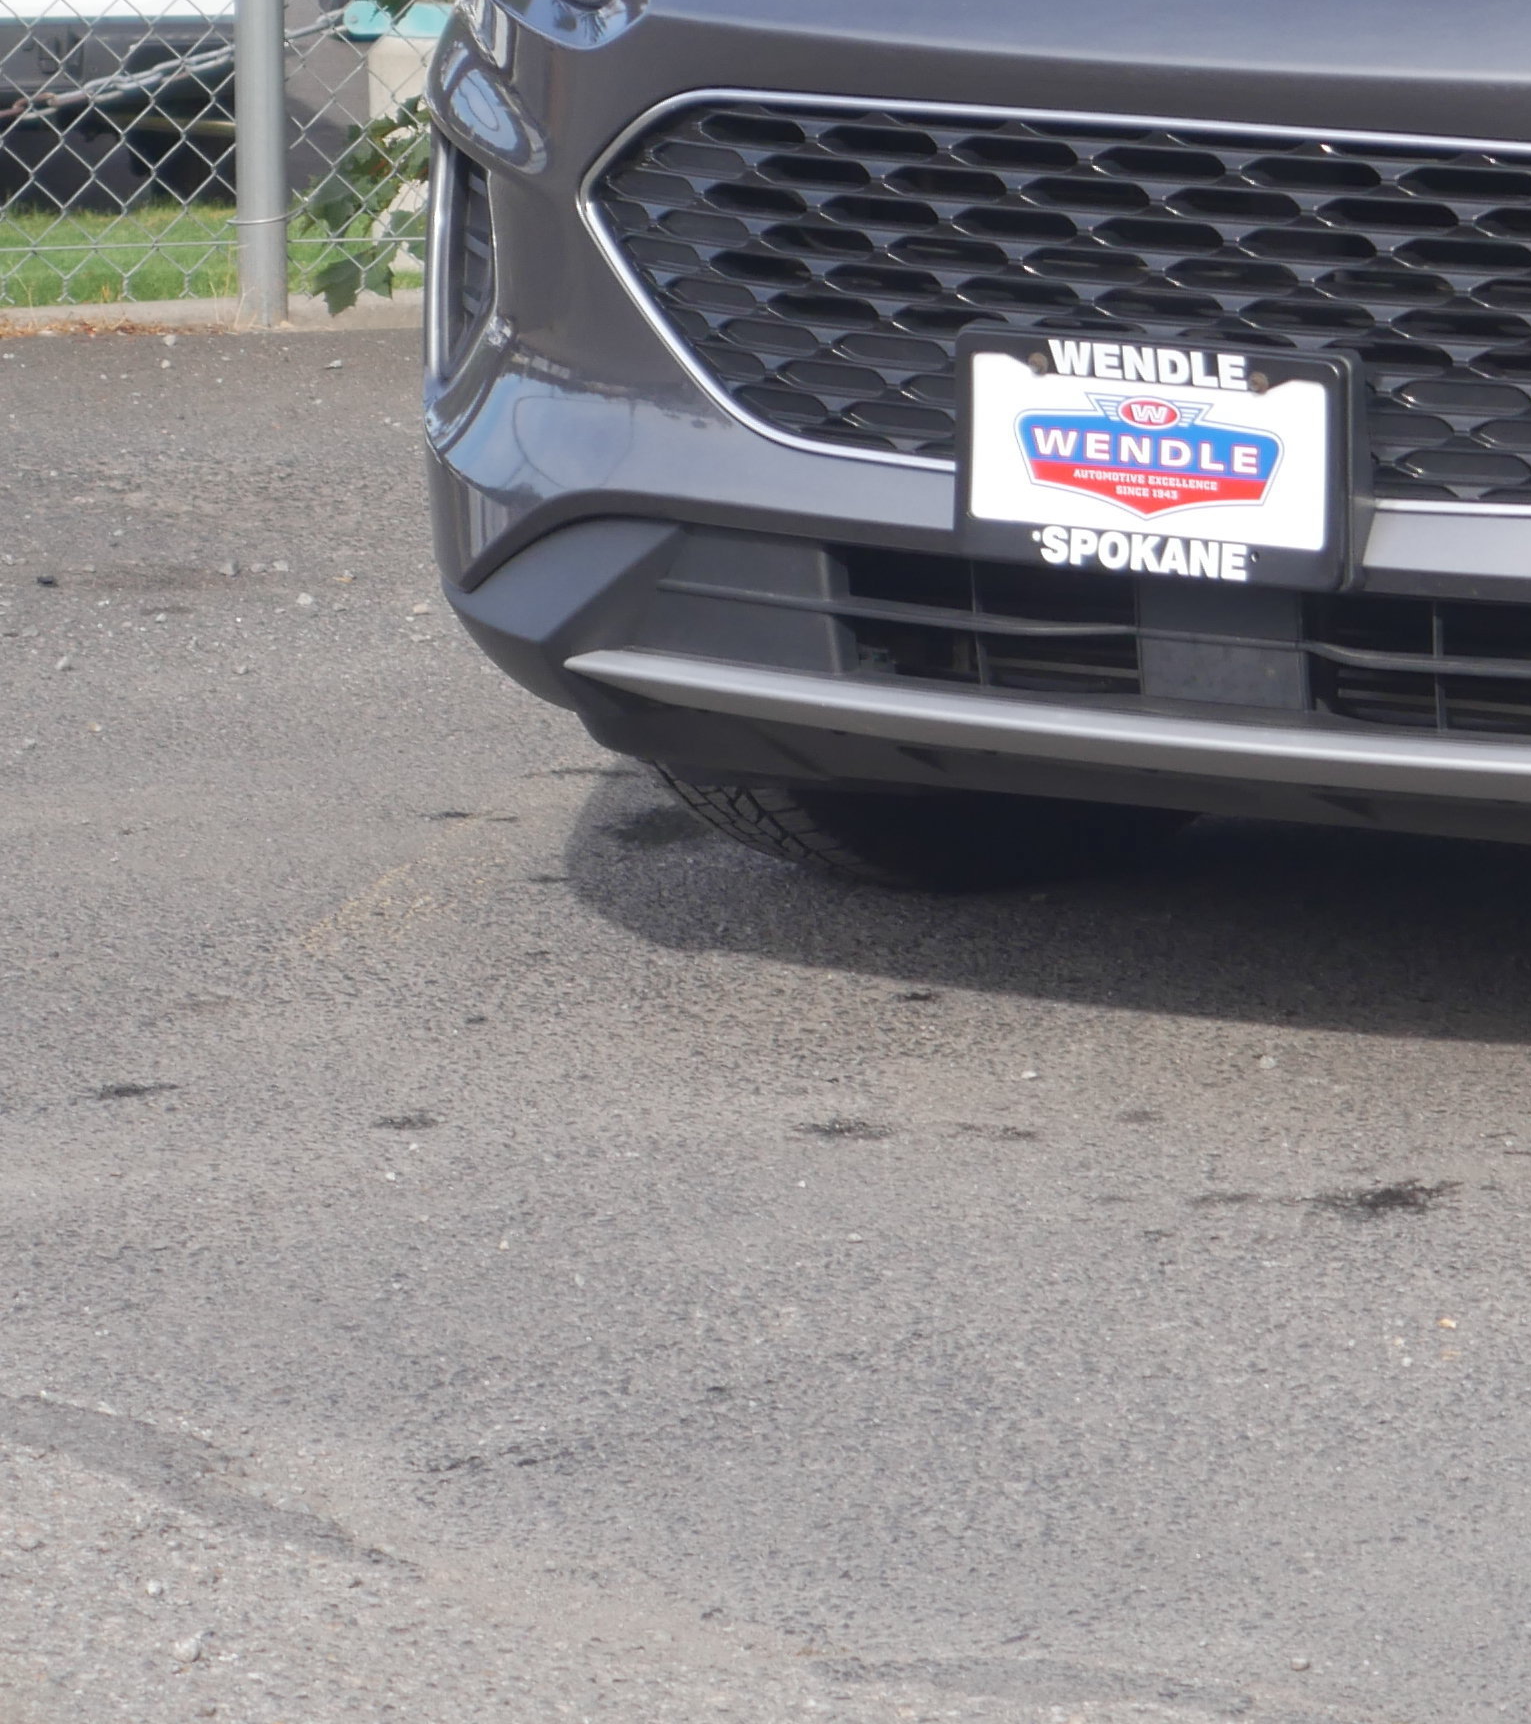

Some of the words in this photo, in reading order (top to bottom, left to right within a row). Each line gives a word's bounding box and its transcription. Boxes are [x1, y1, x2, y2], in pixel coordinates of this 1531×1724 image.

[1048, 339, 1249, 391] WENDLE
[1032, 426, 1259, 475] WENDLE
[1073, 469, 1145, 485] AUTOMOTIVE
[1148, 476, 1218, 491] EXCELLENCE
[1116, 486, 1149, 498] SINCE
[1152, 488, 1178, 500] 1943
[1040, 526, 1248, 581] SPOKANE
